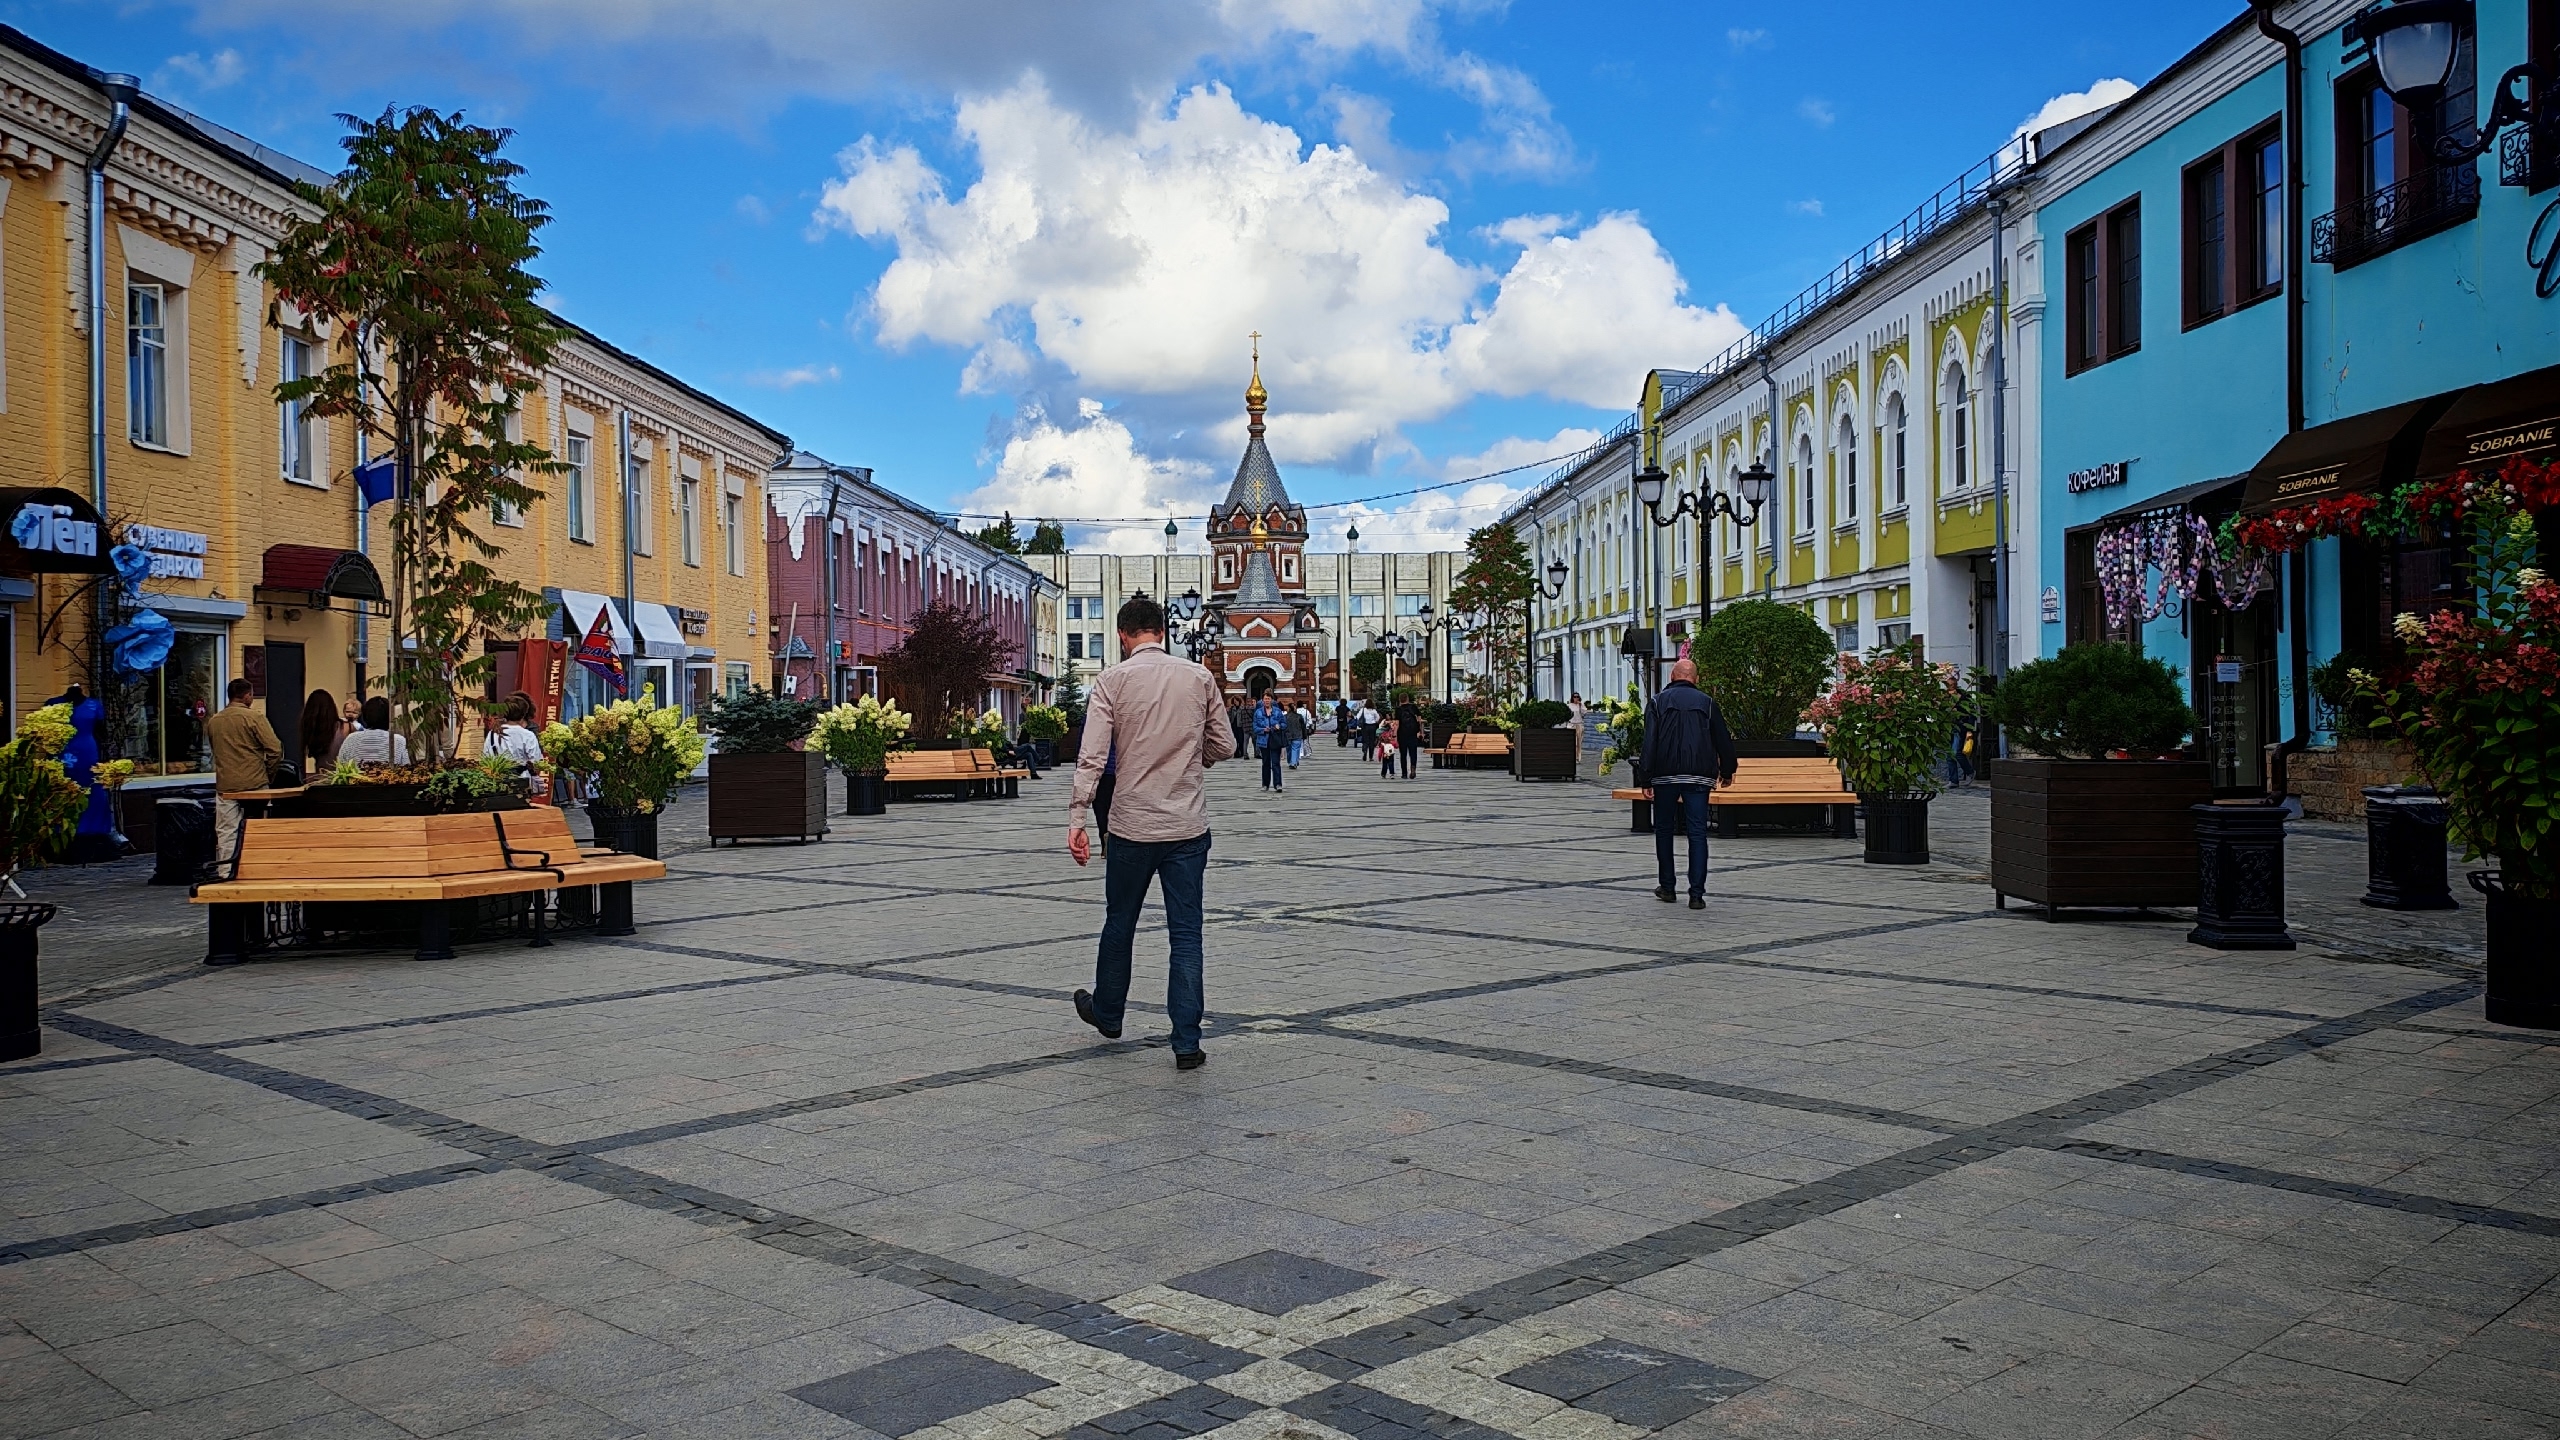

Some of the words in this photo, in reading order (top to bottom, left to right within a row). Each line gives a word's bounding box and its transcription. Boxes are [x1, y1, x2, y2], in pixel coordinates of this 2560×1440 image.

[2468, 426, 2557, 454] SOBRANIE
[2277, 472, 2341, 494] SOBRANIE
[128, 523, 208, 555] СУВЕНИРЫ
